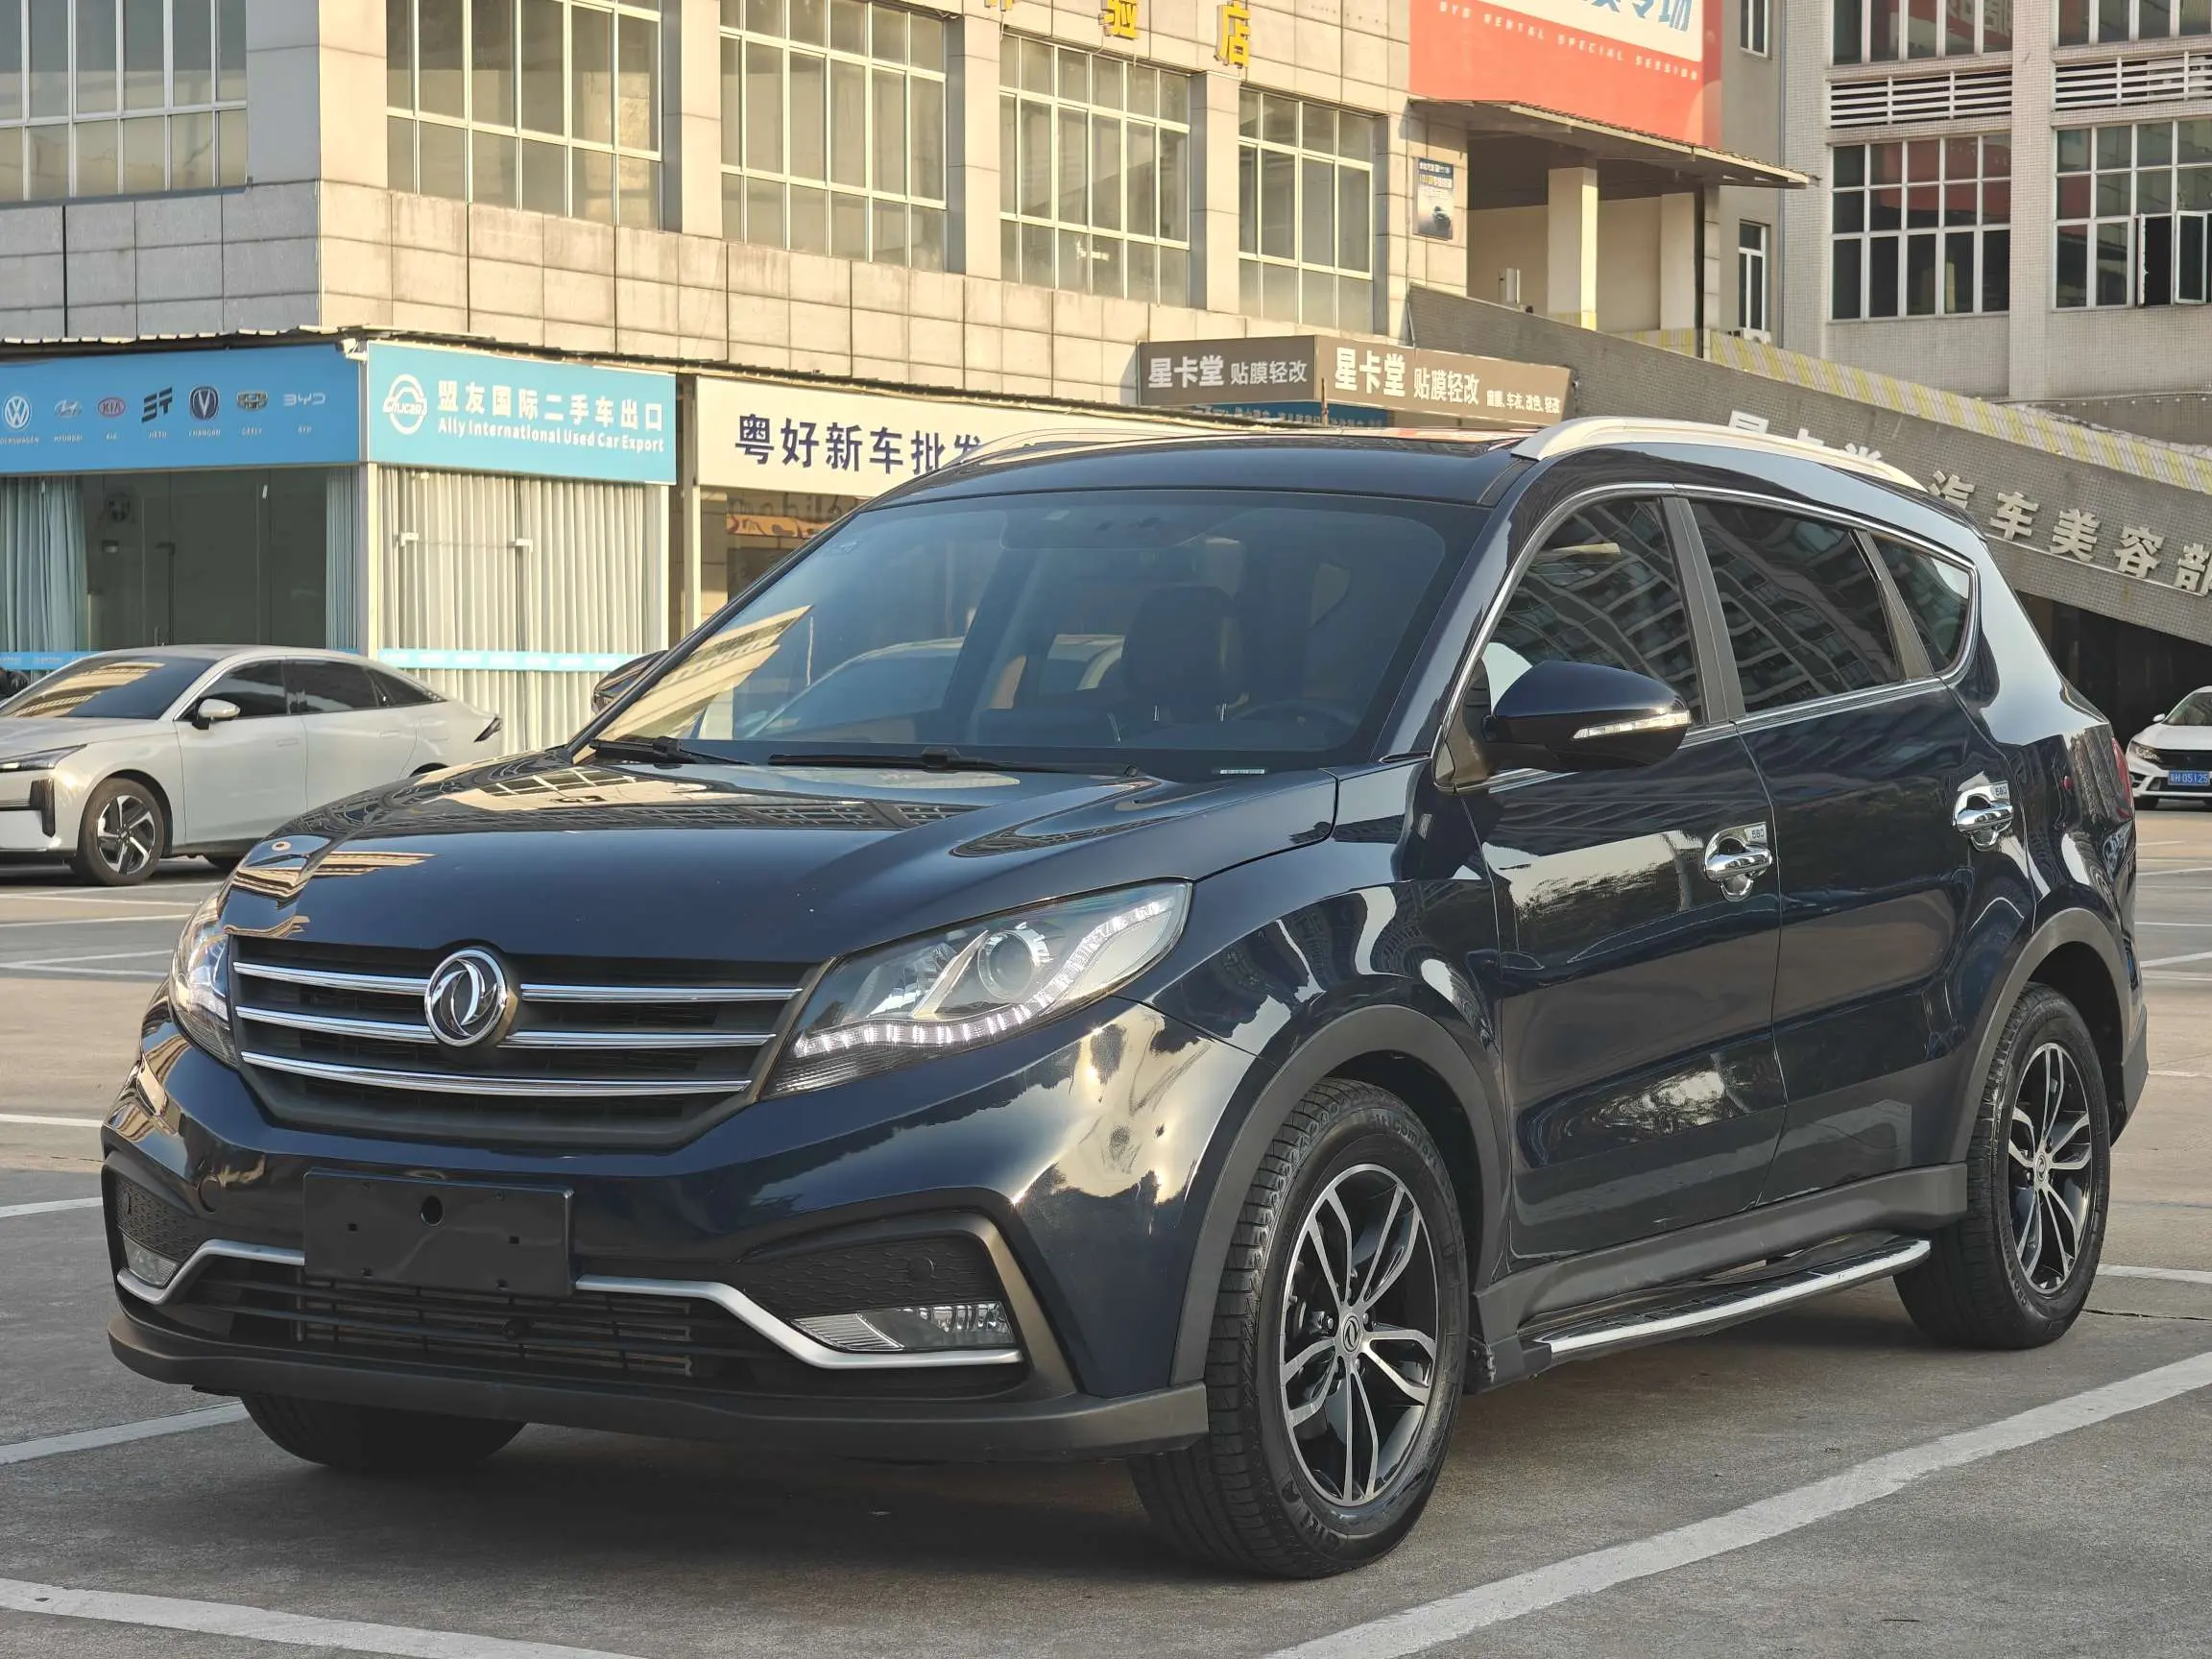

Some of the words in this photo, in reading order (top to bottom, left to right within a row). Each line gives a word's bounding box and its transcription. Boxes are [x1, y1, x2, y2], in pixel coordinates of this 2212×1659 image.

[1483, 13, 1545, 40] RENTAL
[1558, 35, 1624, 61] SPECIAL
[1635, 55, 1698, 82] SESSION
[1148, 354, 1225, 389] 星卡堂
[1230, 360, 1308, 385] 贴膜轻改
[1334, 347, 1407, 397] 星卡堂
[1413, 367, 1479, 405] 贴膜轻改
[438, 380, 662, 432] 盟友国际二手车出口
[439, 417, 466, 439] Ally
[469, 420, 561, 445] International
[564, 428, 595, 447] Used
[597, 432, 620, 448] Car
[621, 434, 664, 453] Export
[1751, 828, 1765, 839] 580
